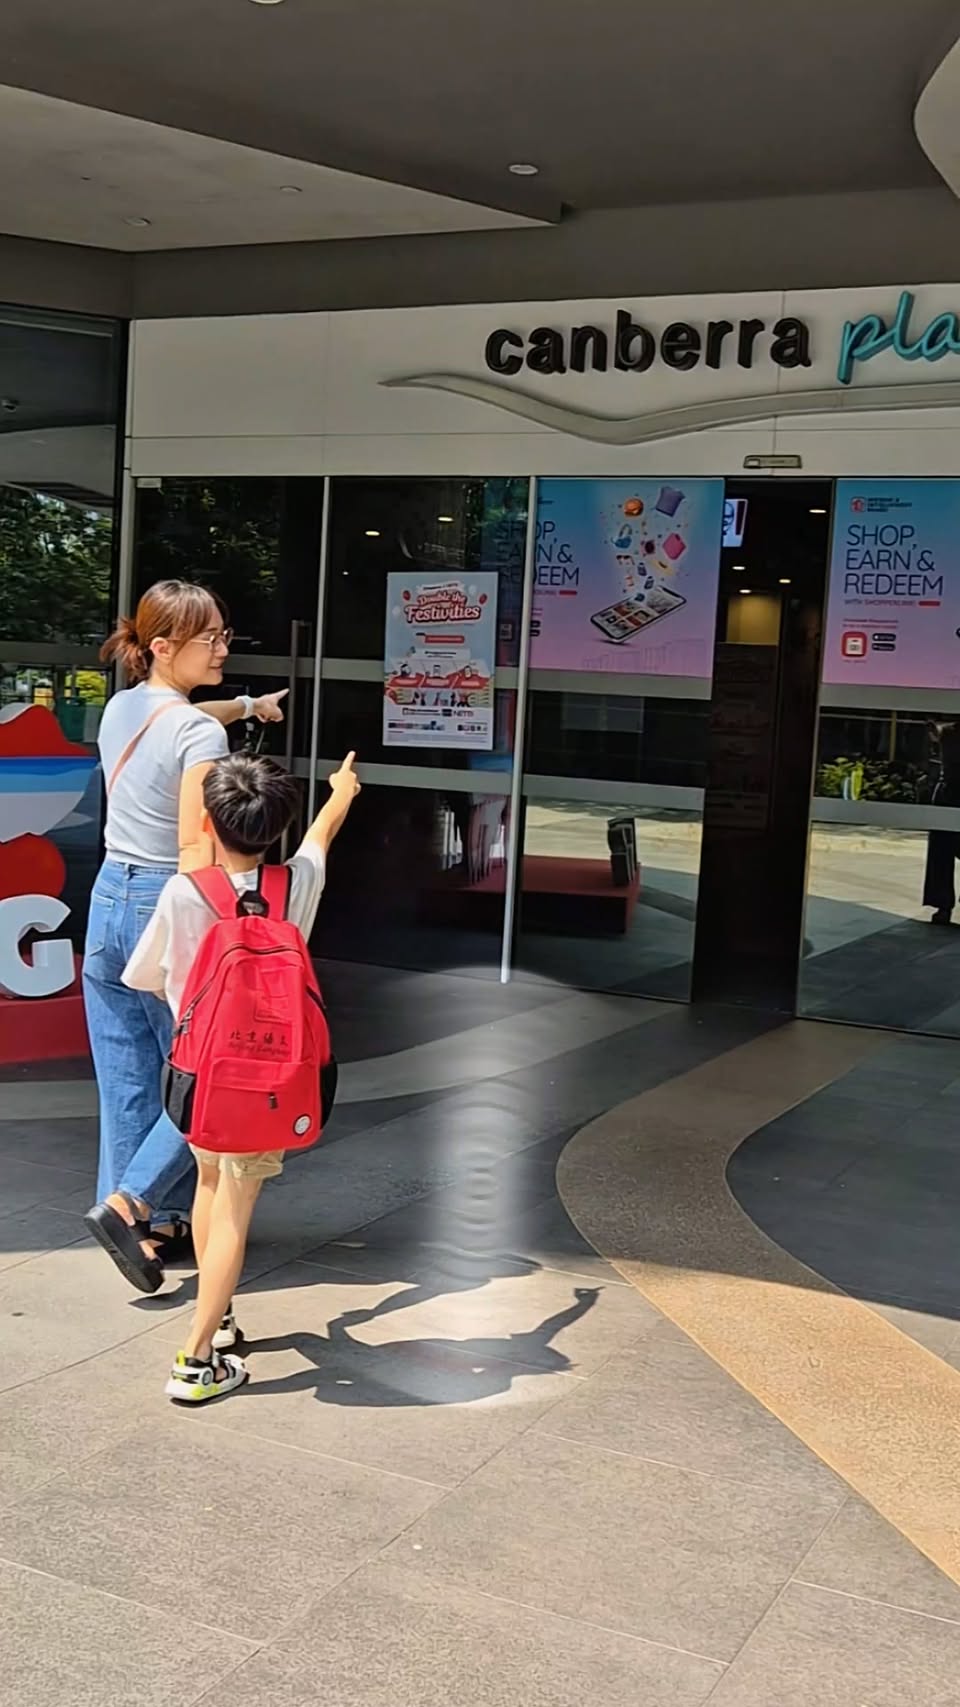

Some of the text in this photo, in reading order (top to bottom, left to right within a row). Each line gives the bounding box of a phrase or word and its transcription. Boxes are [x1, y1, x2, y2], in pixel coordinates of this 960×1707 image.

[485, 309, 812, 375] canberra
[847, 524, 917, 550] SHOP,
[557, 544, 573, 563] &
[846, 549, 935, 571] EARN &
[843, 573, 944, 596] REDEEM
[405, 605, 481, 622] Festivities
[0, 893, 76, 998] G
